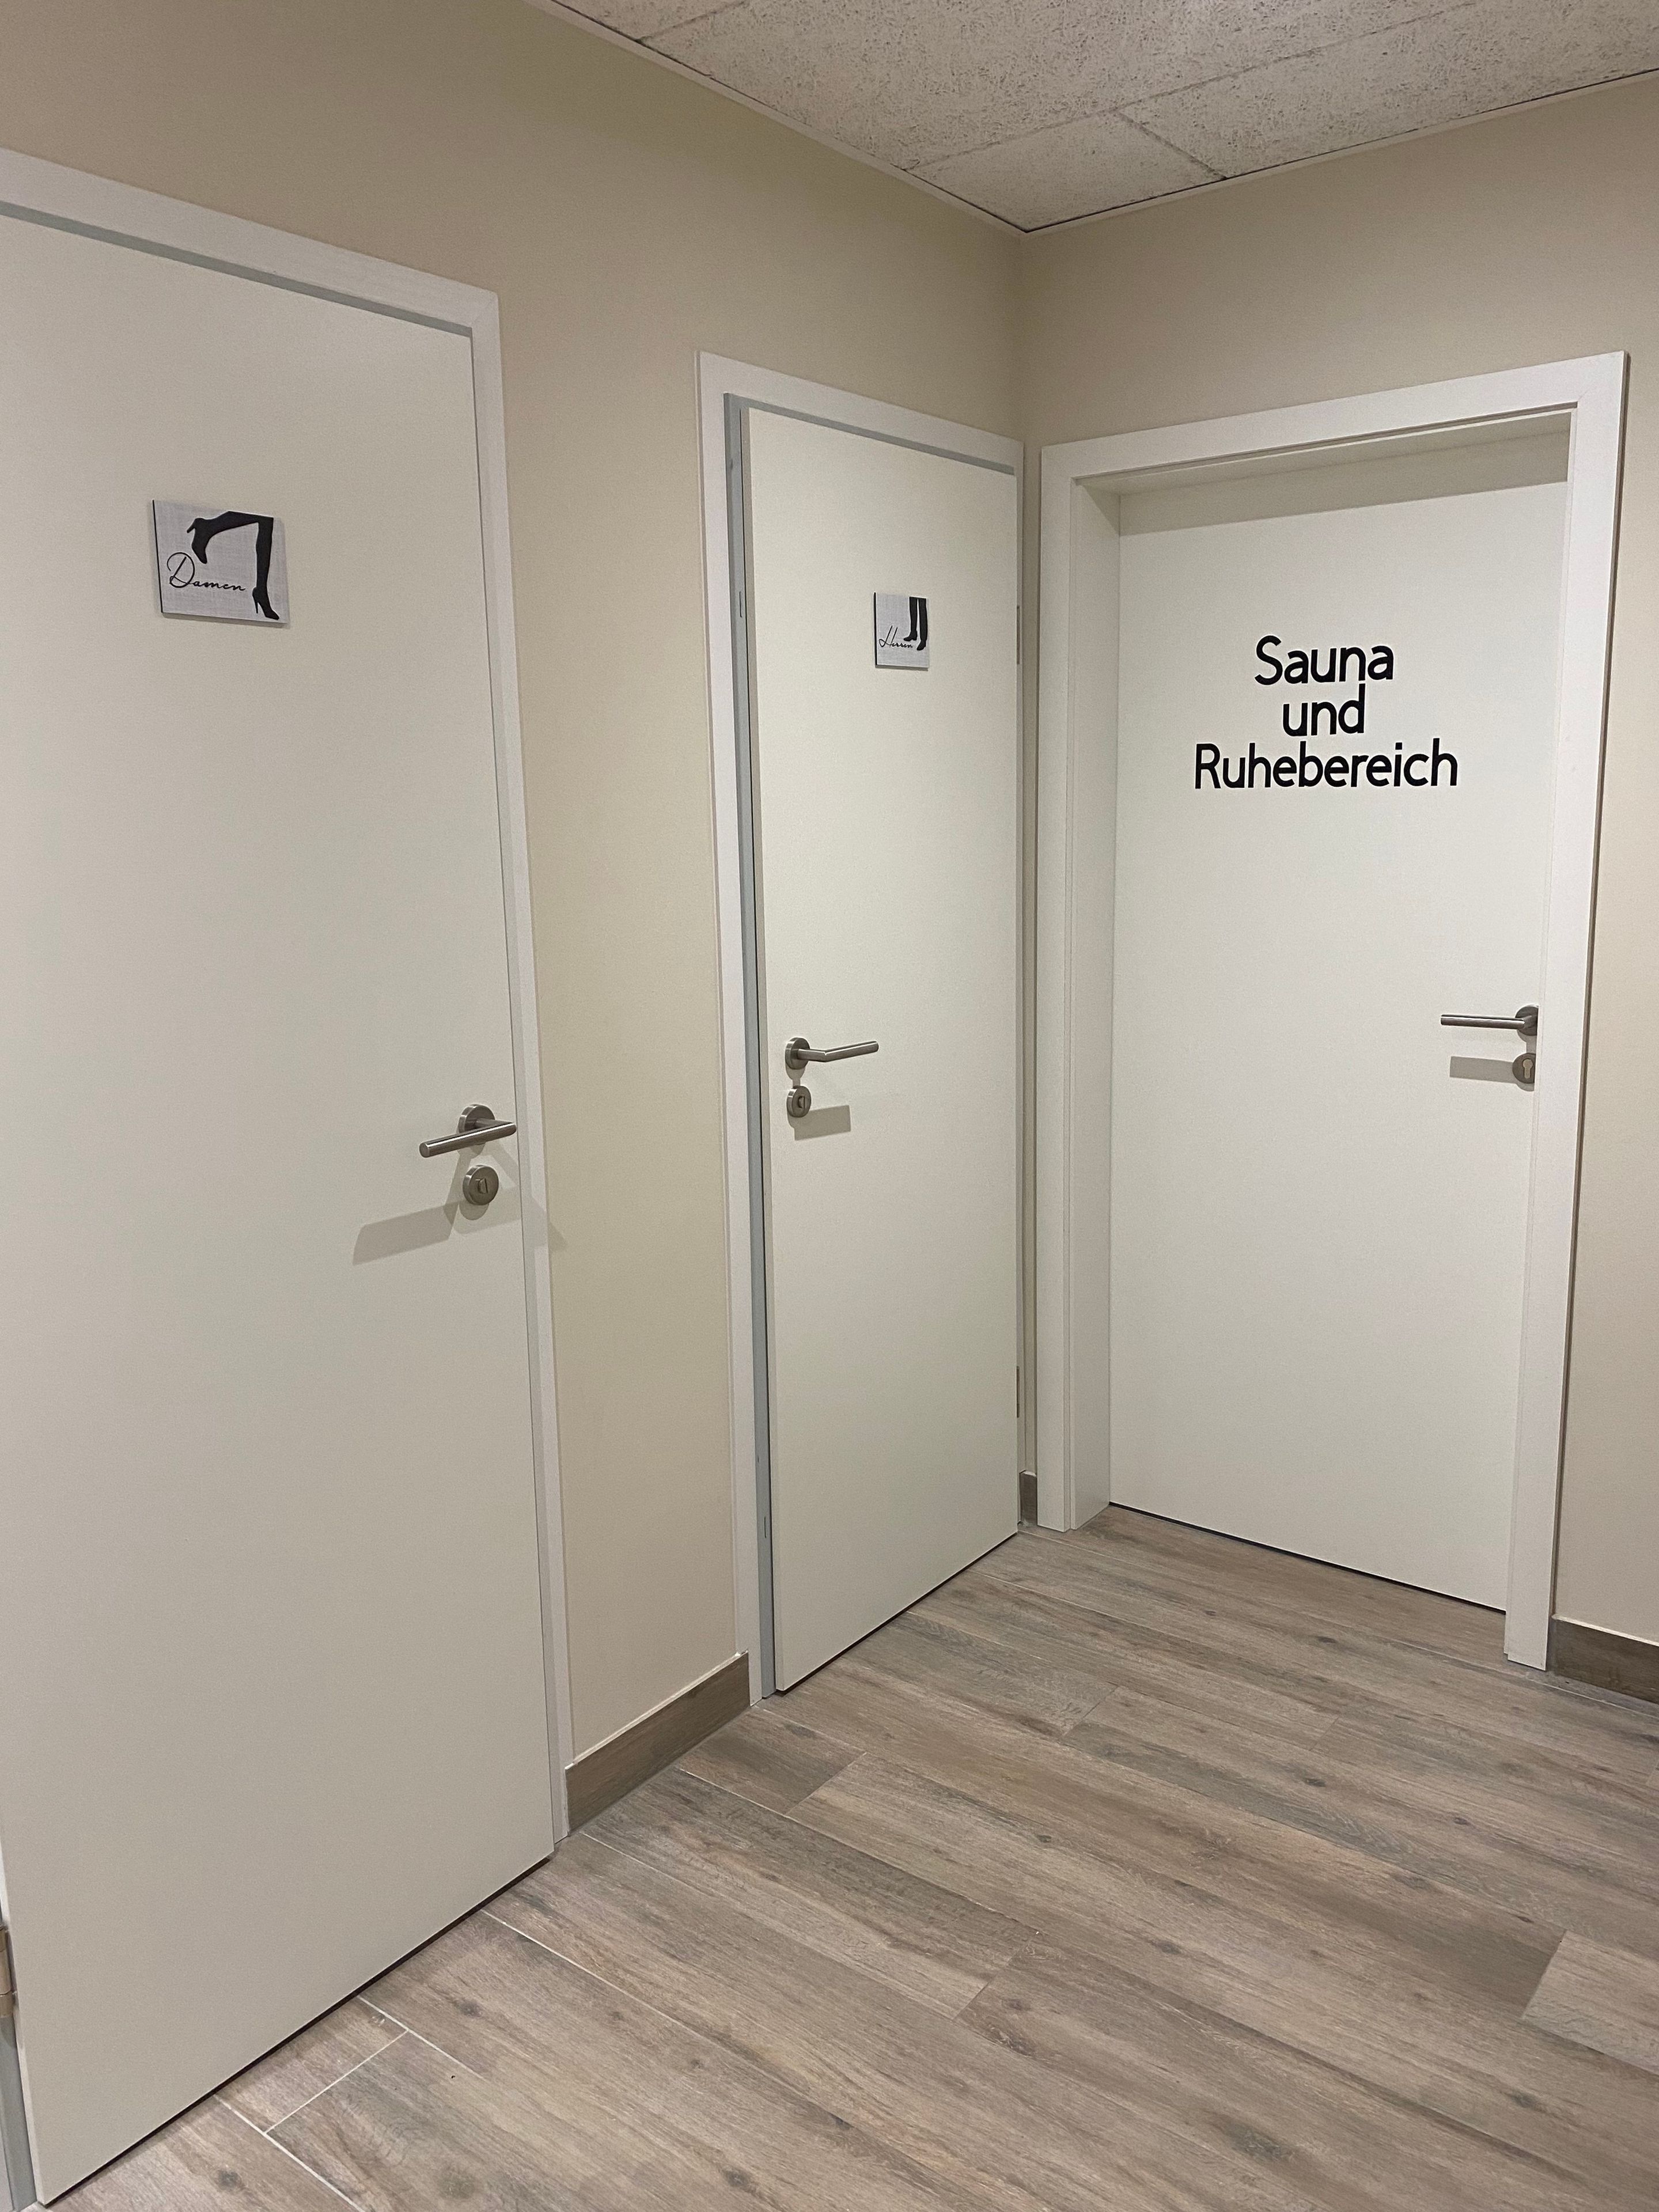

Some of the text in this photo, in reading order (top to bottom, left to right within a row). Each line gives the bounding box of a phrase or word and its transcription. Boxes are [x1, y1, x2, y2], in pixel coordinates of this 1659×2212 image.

[166, 551, 246, 592] Damen
[878, 625, 914, 649] Herren
[1254, 634, 1395, 685] Sauna
[1282, 683, 1366, 737] und
[1194, 737, 1459, 789] Ruhebereich
